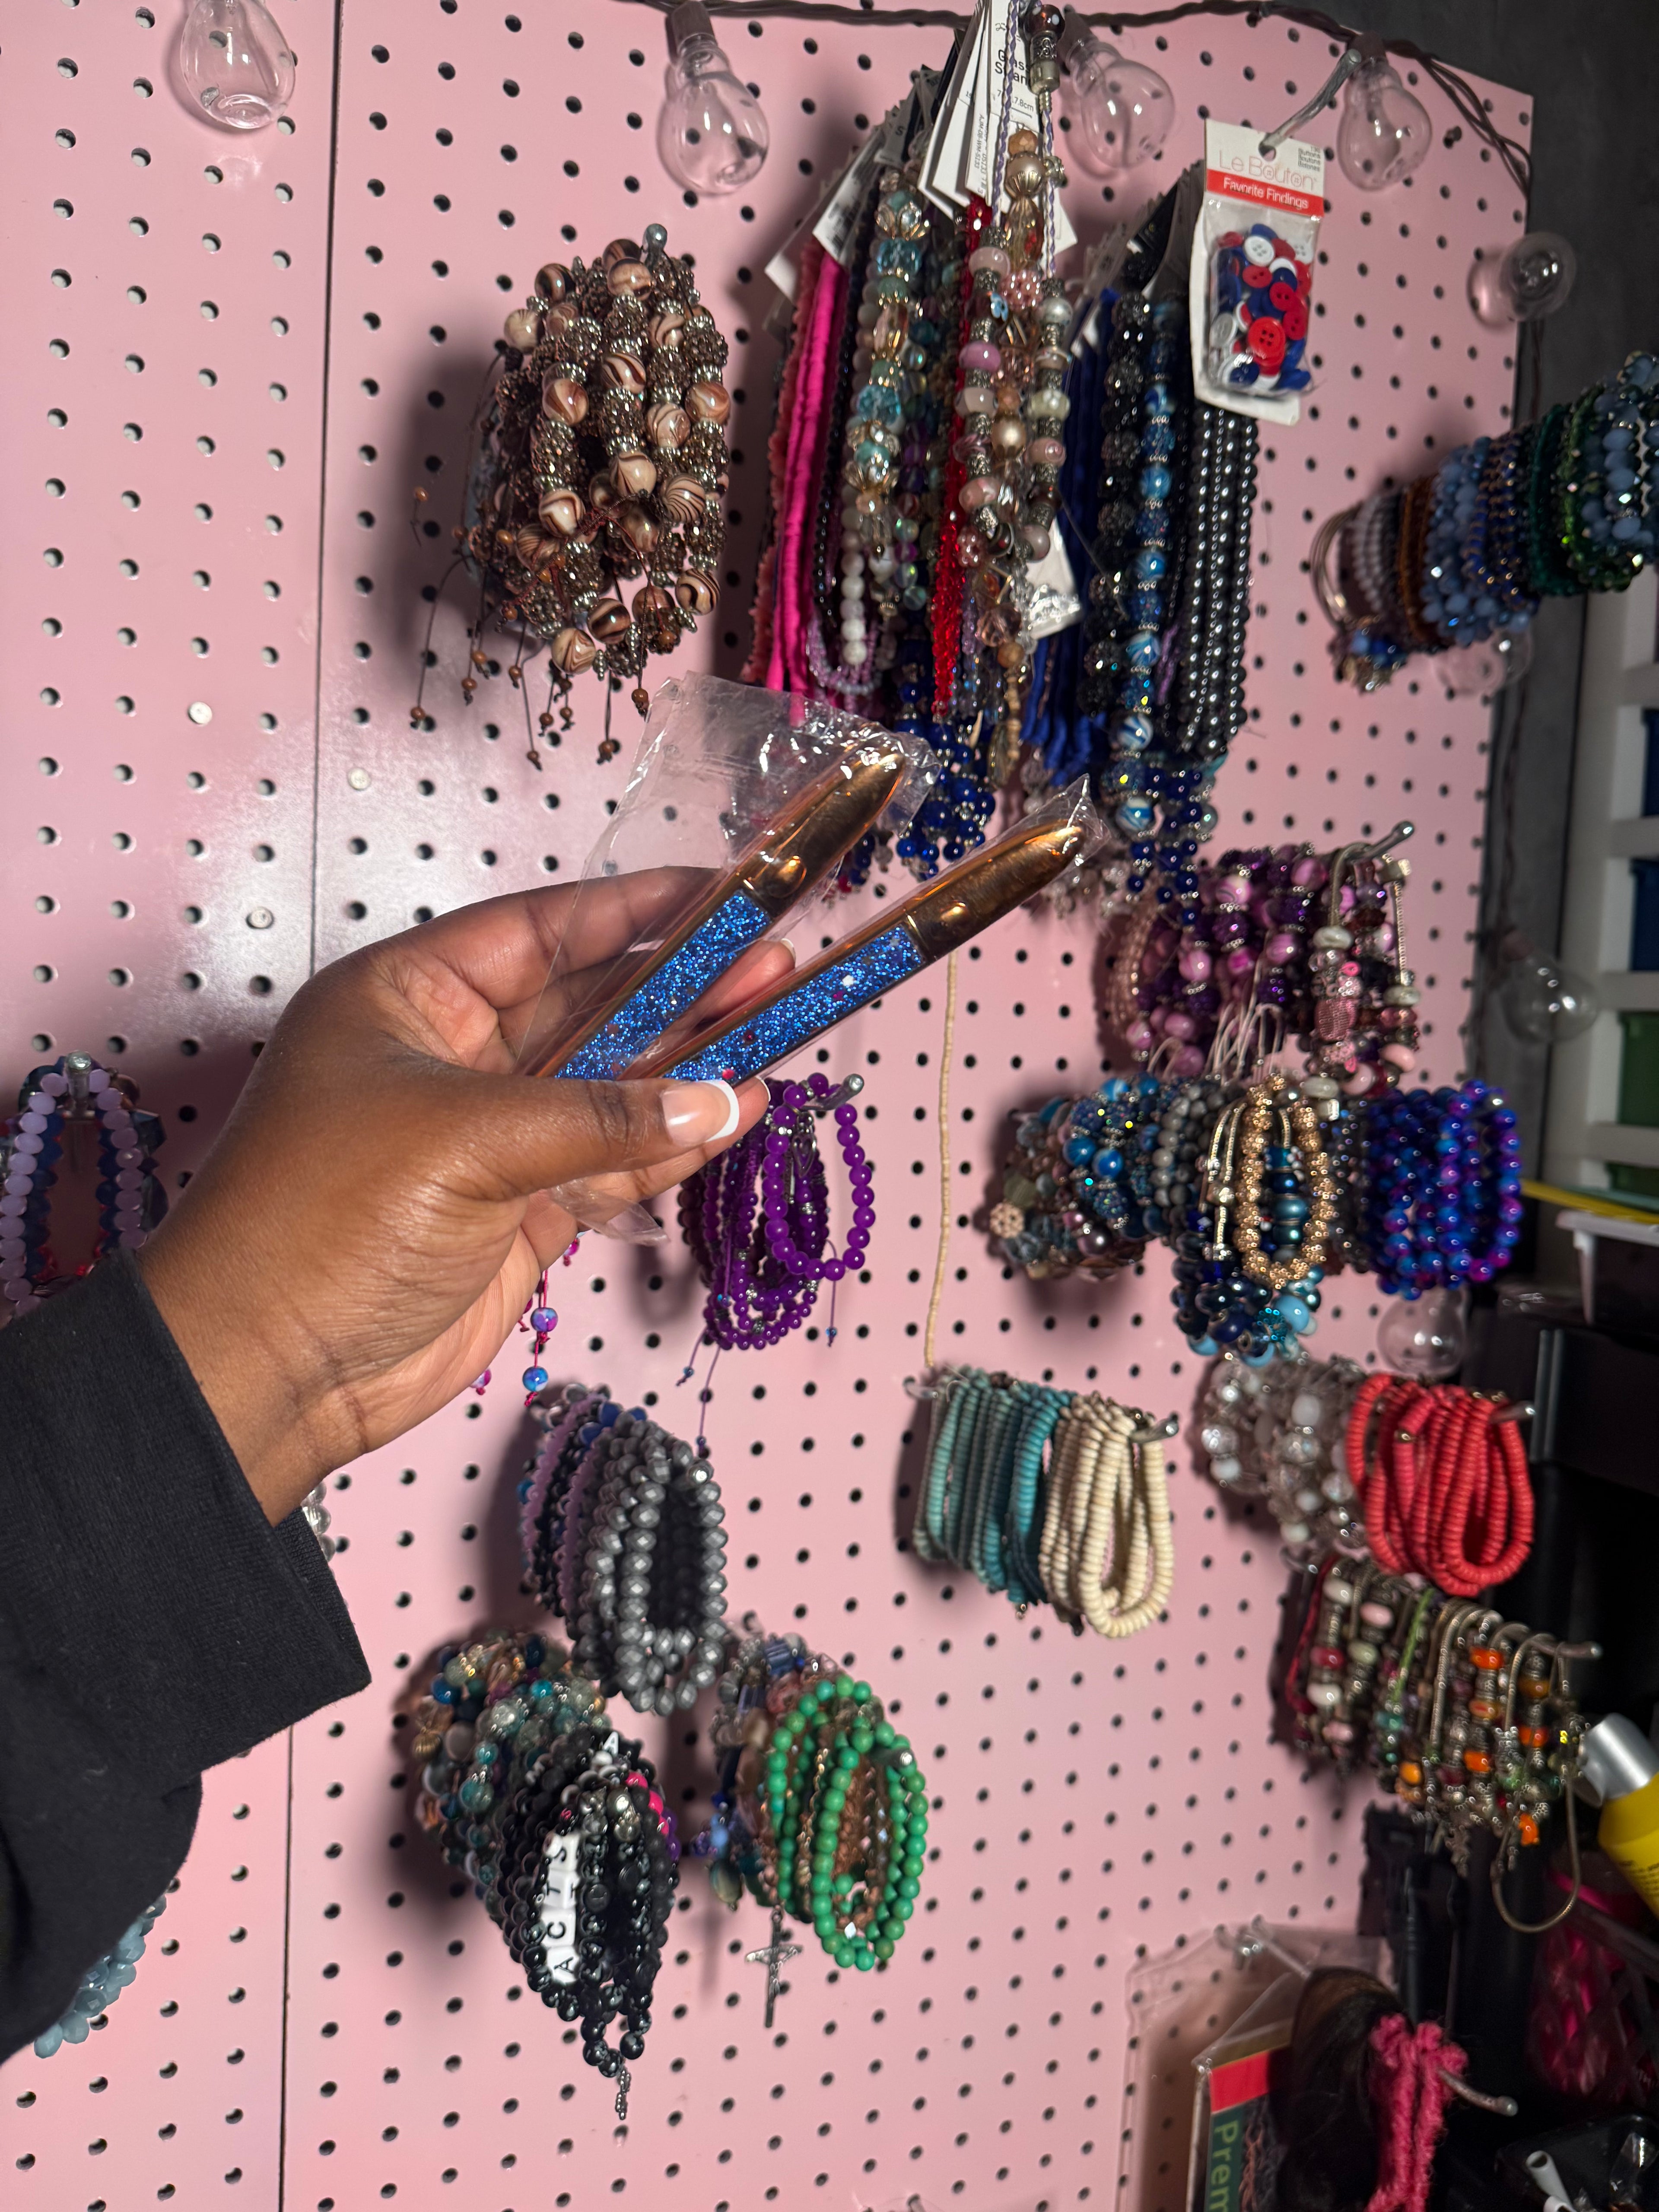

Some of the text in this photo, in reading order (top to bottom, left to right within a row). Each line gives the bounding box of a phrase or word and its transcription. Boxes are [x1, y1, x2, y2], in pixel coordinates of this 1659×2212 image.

[998, 49, 1030, 73] Gass
[1220, 150, 1314, 191] Le Bouton
[1223, 177, 1309, 210] Favorite Findings
